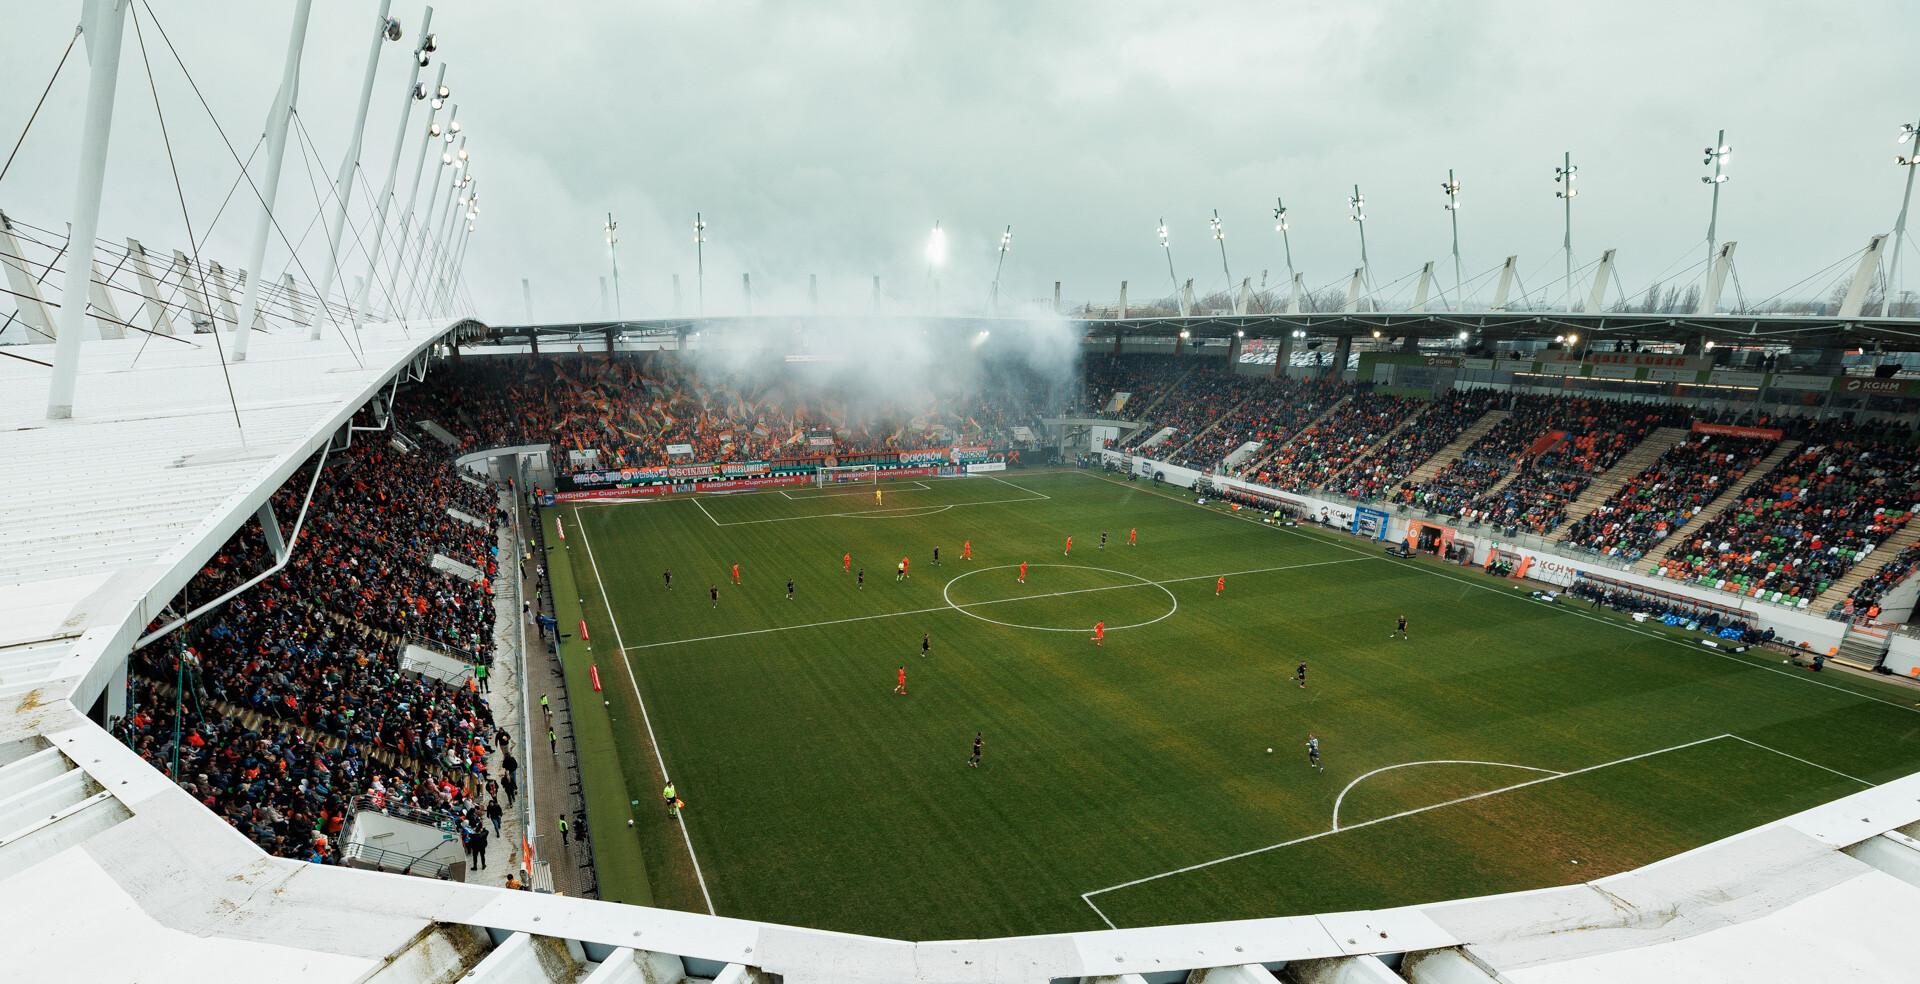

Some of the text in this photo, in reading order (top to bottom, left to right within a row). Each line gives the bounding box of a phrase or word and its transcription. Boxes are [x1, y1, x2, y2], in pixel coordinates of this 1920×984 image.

[1862, 381, 1900, 391] KGHM
[702, 481, 737, 489] FANSHOP
[745, 478, 774, 487] Cuprum
[774, 476, 796, 484] Arena
[598, 489, 631, 498] Cuprum
[631, 487, 655, 495] Arena
